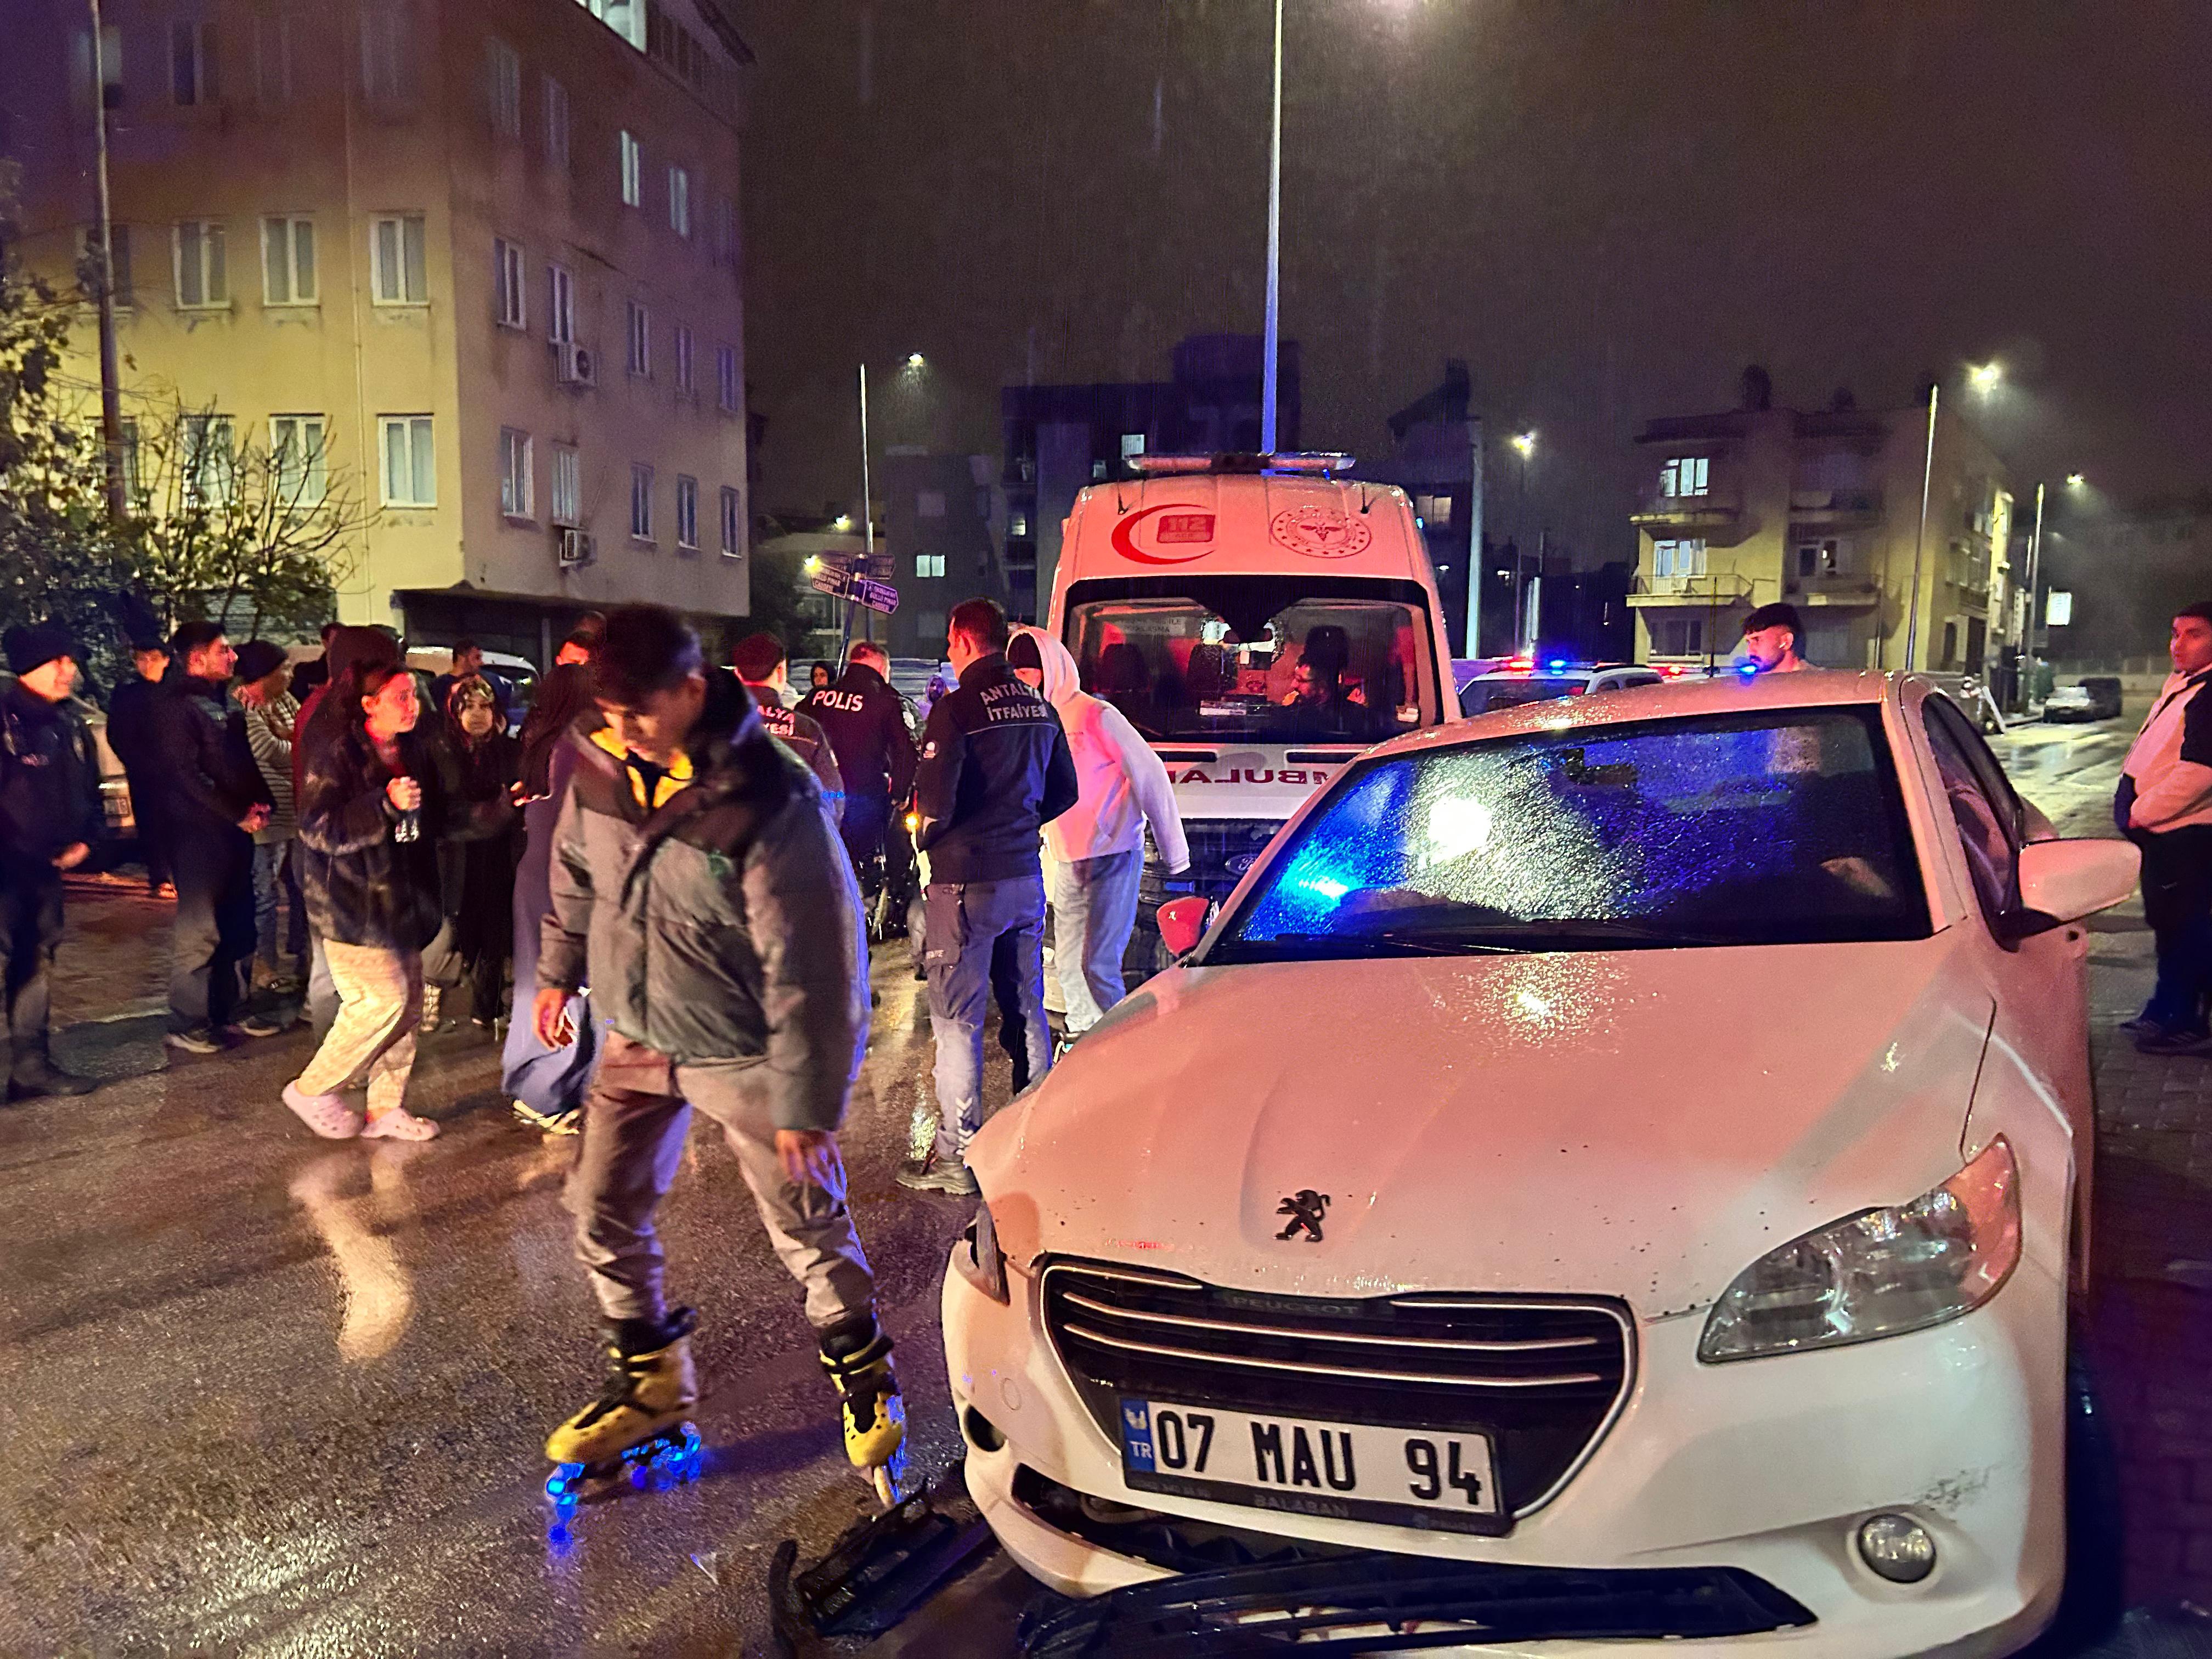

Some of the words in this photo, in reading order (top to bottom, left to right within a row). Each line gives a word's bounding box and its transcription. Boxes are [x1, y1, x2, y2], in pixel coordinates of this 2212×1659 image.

[980, 683, 1043, 706] ANTALYA
[1129, 1440, 1153, 1459] TR
[1156, 1410, 1215, 1472] 07
[1250, 1421, 1356, 1491] MAU
[1404, 1438, 1482, 1505] 94
